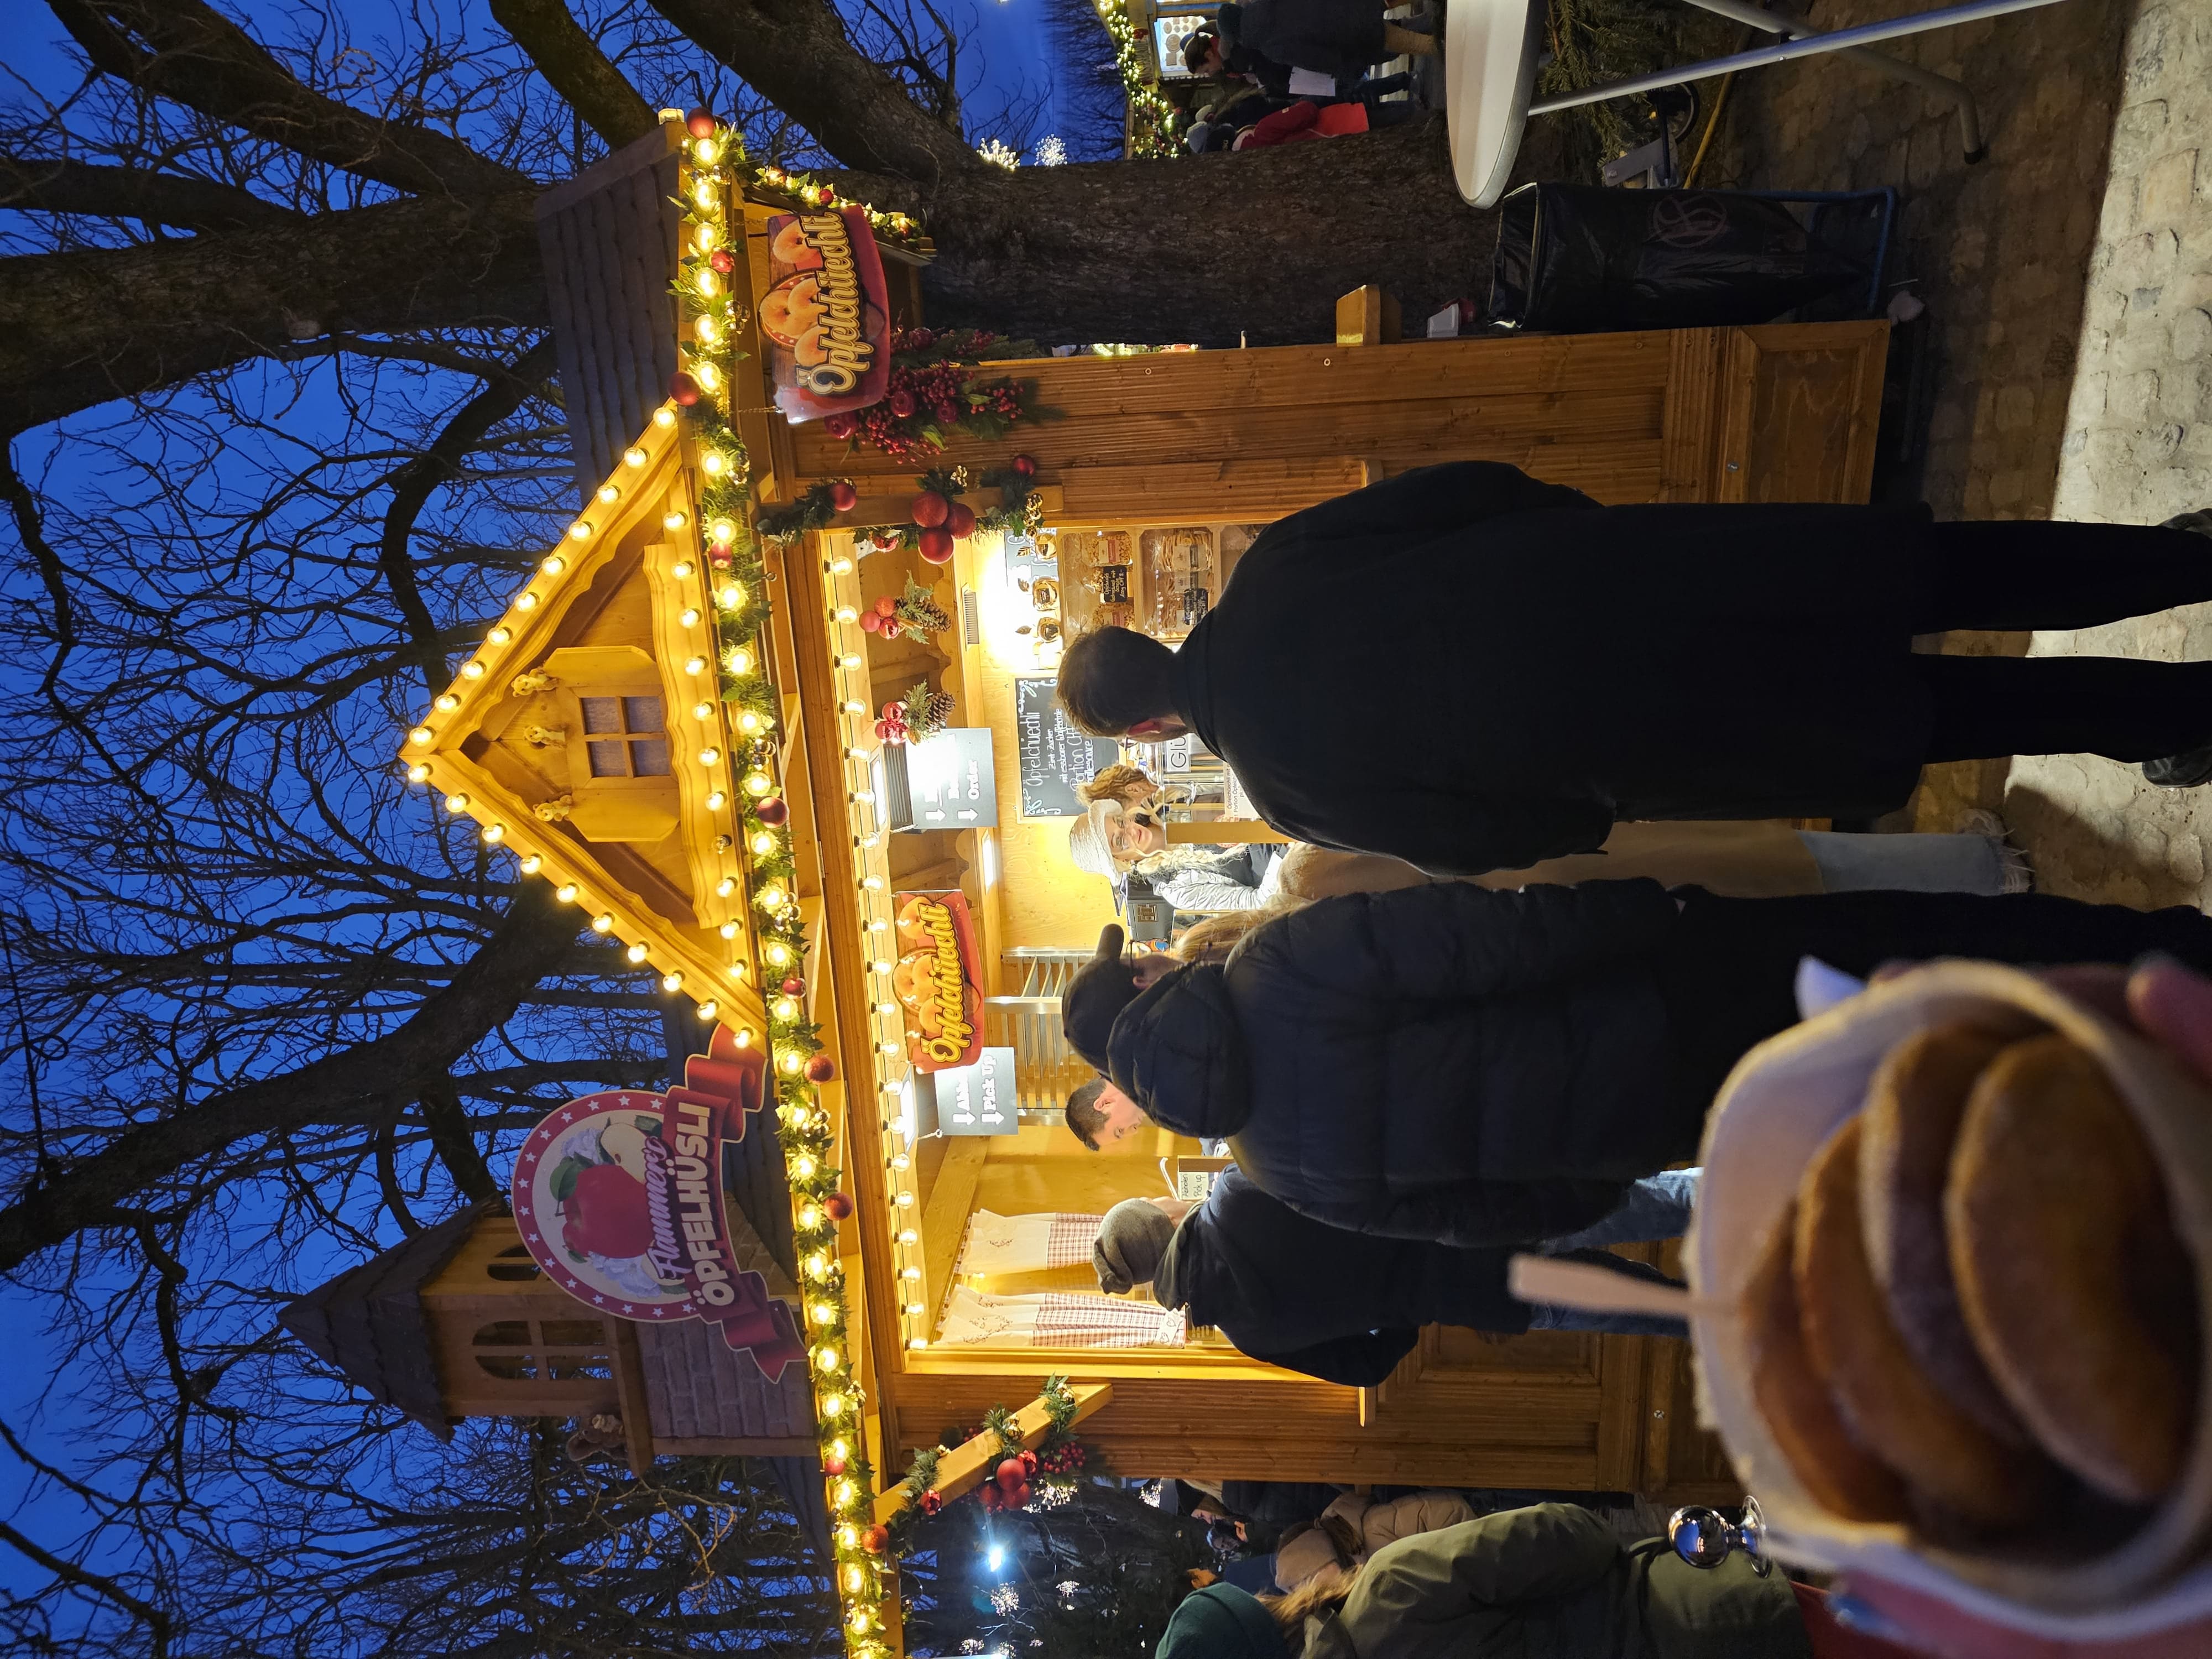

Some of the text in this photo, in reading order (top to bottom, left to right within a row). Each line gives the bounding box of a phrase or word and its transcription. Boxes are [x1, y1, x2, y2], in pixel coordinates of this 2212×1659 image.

[796, 212, 874, 394] Öpfelchüechli
[1020, 712, 1050, 786] Öpfelchüechli
[1057, 741, 1067, 773] essbarer
[1068, 748, 1084, 791] Portion
[1170, 736, 1187, 768] Glü
[966, 760, 980, 800] Order
[1059, 773, 1068, 783] mit
[918, 902, 973, 1062] Öpfelchüechli
[981, 1055, 997, 1111] Pick Up
[643, 1138, 691, 1277] Flammer's
[666, 1102, 735, 1306] ÖPFELHÜSLI
[1193, 1175, 1206, 1197] Pick up
